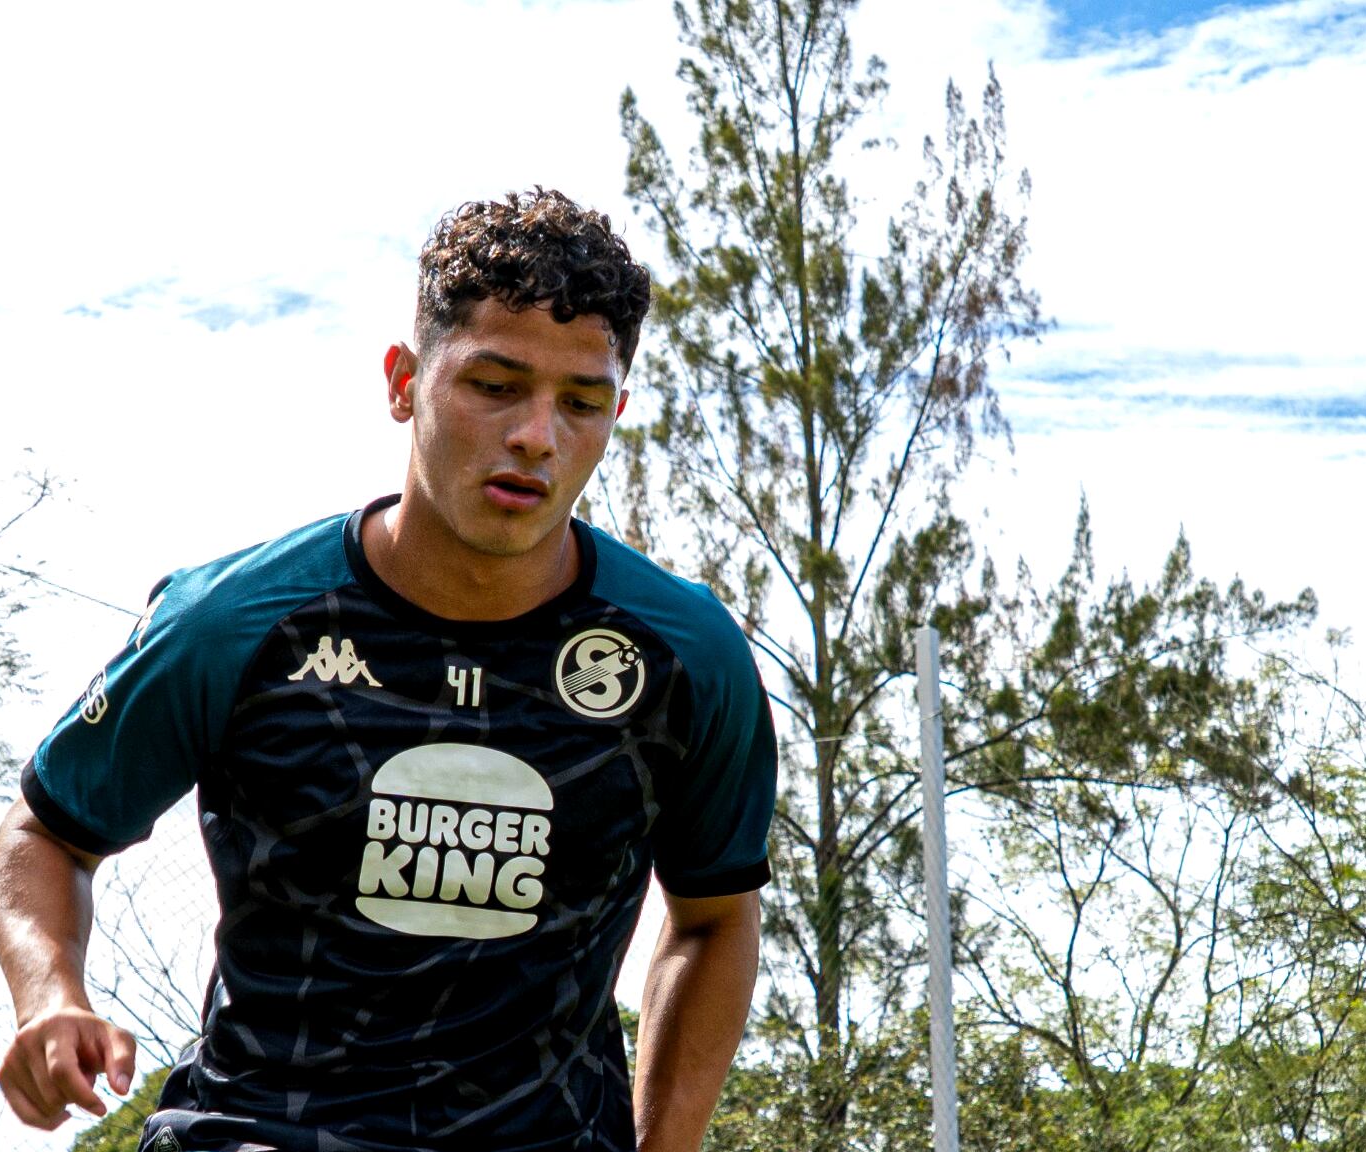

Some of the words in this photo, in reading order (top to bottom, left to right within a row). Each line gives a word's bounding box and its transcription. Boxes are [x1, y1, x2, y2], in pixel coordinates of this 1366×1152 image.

[447, 665, 482, 707] 41
[366, 798, 551, 856] BURGER
[358, 840, 545, 910] KING
